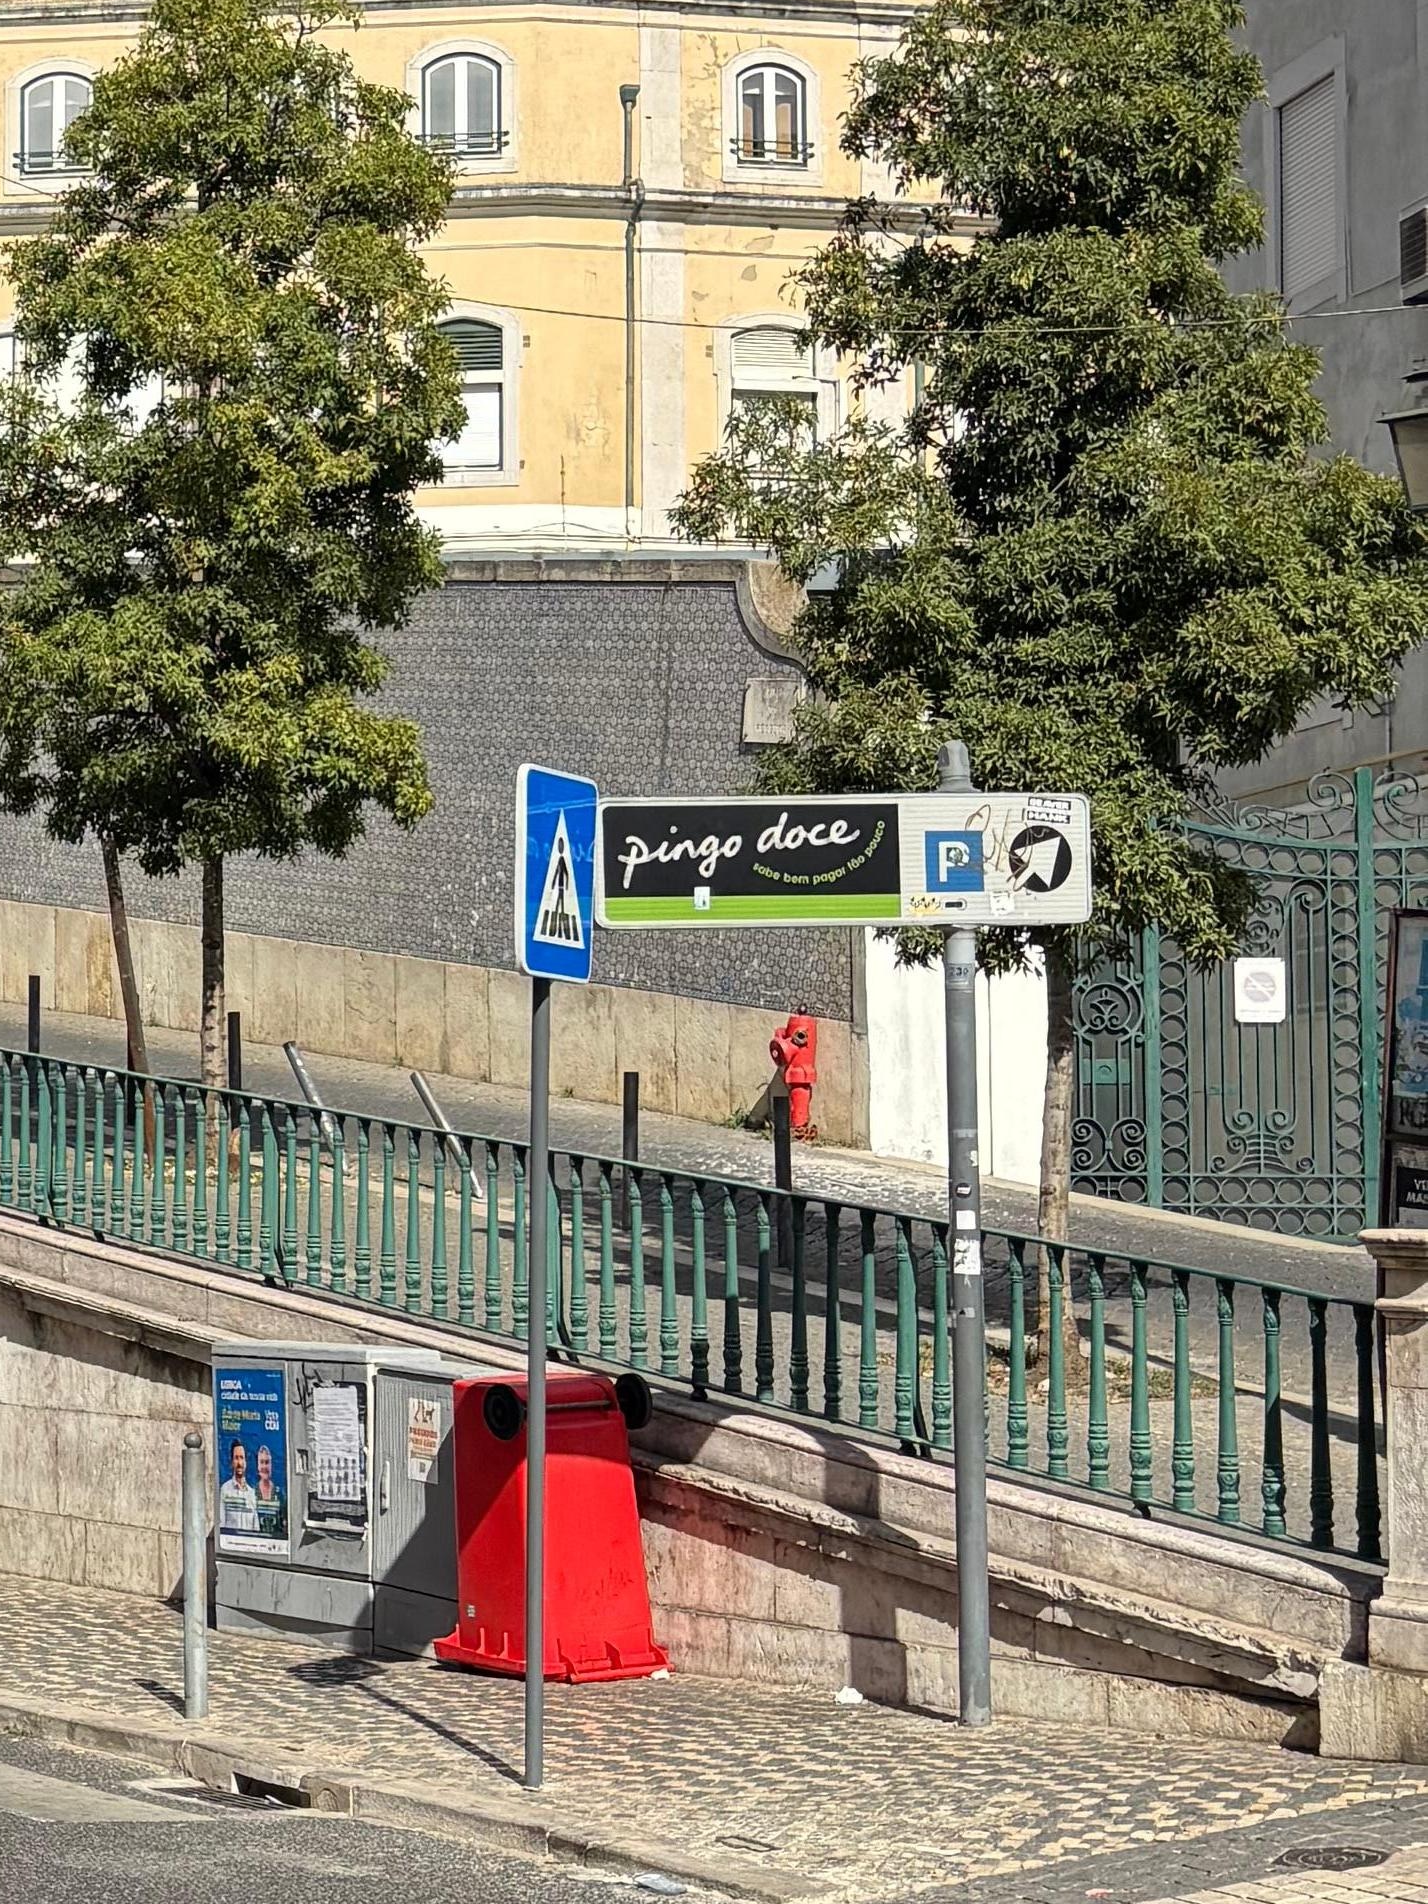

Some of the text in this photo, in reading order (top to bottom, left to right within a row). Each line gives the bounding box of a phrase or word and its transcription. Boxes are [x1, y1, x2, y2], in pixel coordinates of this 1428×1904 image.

[618, 811, 862, 889] pingo doce
[753, 863, 781, 881] sabe
[813, 866, 846, 886] pagar
[864, 820, 886, 858] pouco
[939, 841, 970, 883] P
